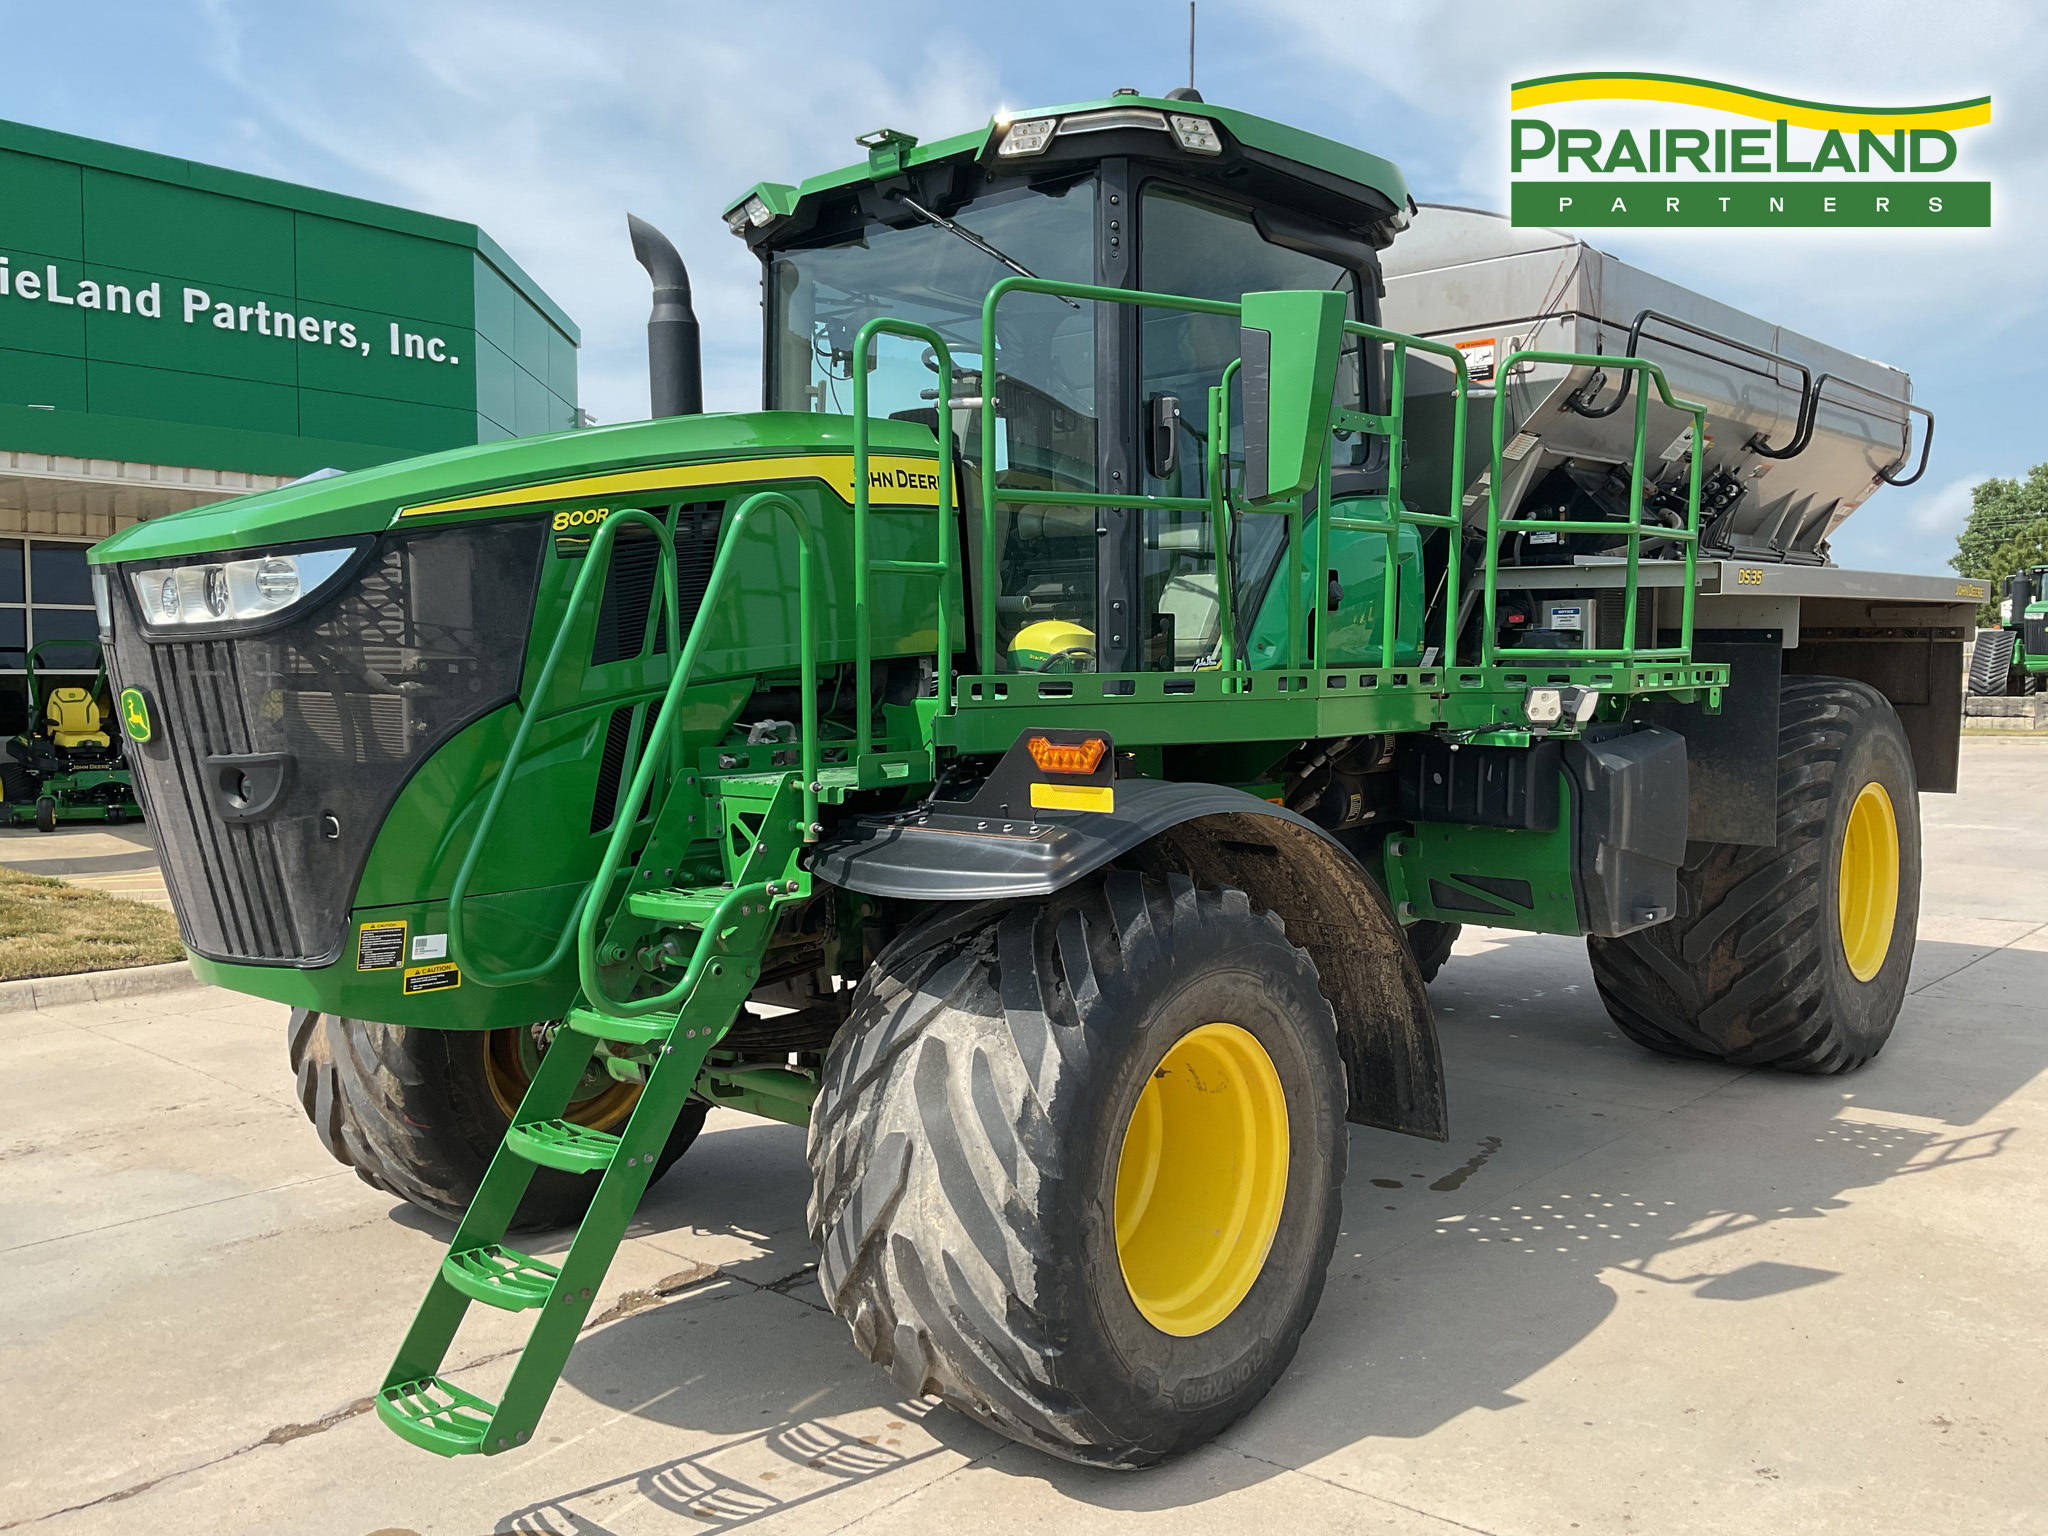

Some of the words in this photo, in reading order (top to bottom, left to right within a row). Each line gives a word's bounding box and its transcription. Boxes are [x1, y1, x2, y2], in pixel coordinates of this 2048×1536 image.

[183, 287, 370, 356] Partners,
[390, 323, 459, 365] Inc.
[896, 469, 939, 490] DEER
[552, 507, 609, 531] 800R
[1738, 568, 1751, 585] DS
[1751, 568, 1763, 585] 35
[422, 965, 452, 974] CAUTION
